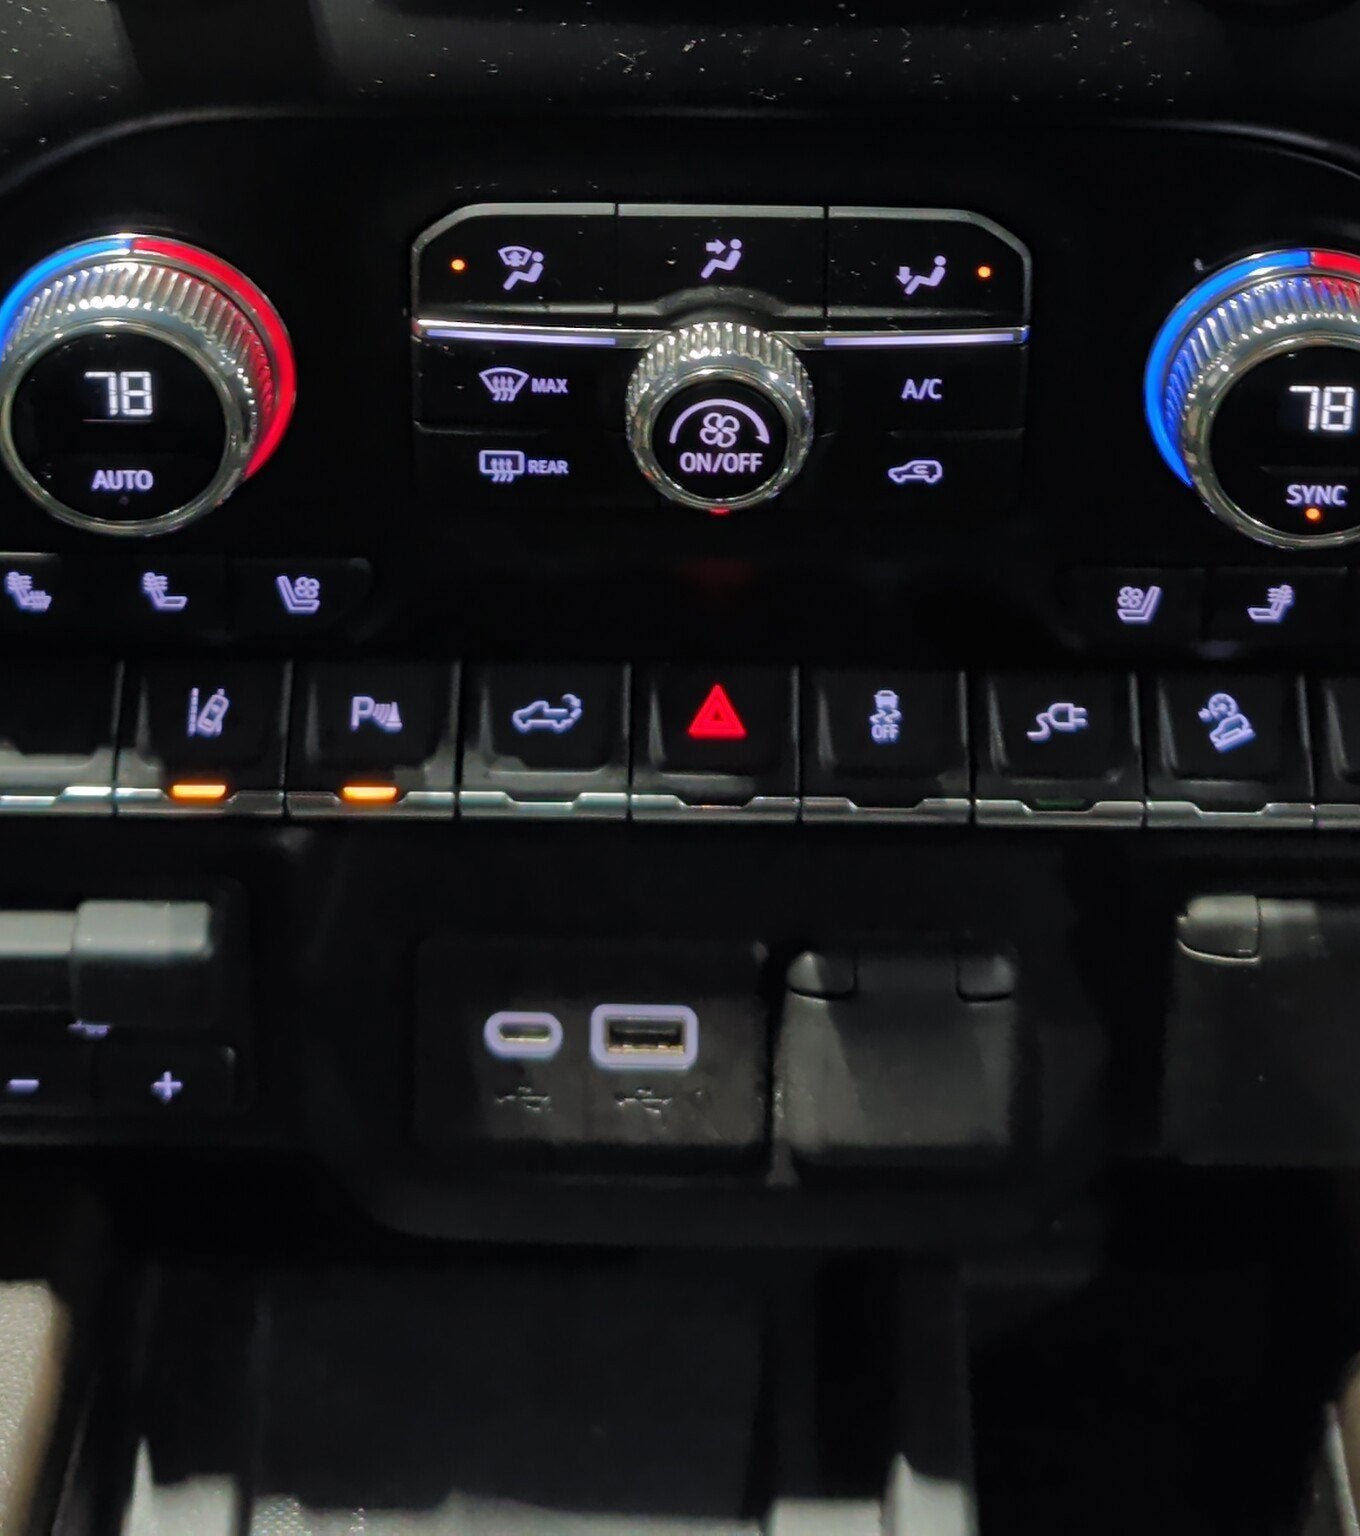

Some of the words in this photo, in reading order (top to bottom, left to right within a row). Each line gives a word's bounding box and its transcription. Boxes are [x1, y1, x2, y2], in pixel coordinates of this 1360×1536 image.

[83, 371, 154, 417] 78
[532, 378, 568, 395] MAX
[902, 379, 942, 400] A/C
[1288, 386, 1354, 432] 78
[528, 459, 568, 475] REAR
[680, 453, 762, 474] ON/OFF
[91, 470, 154, 491] AUTO
[1286, 485, 1348, 506] SYNC
[871, 724, 899, 743] OFF
